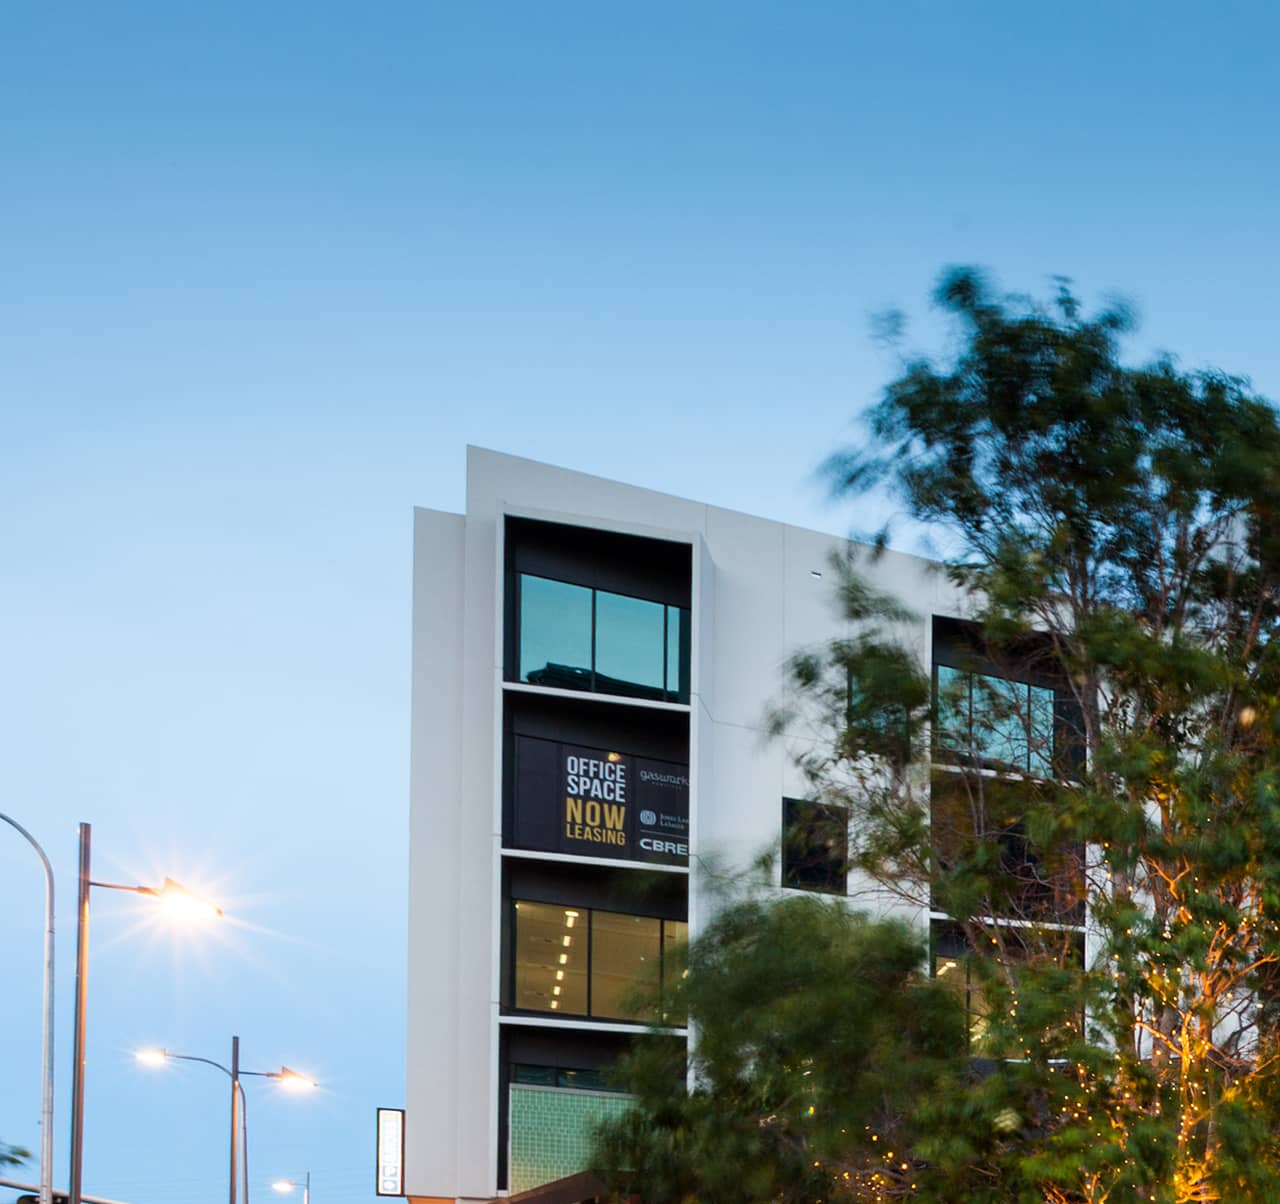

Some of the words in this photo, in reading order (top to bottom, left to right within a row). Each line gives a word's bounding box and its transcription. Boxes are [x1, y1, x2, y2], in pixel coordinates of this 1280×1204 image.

[567, 756, 626, 783] OFFICE
[640, 770, 689, 785] gaswork
[567, 775, 626, 803] SPACE
[566, 797, 626, 830] NOW
[566, 823, 626, 846] LEASING
[640, 838, 689, 856] CBRE
